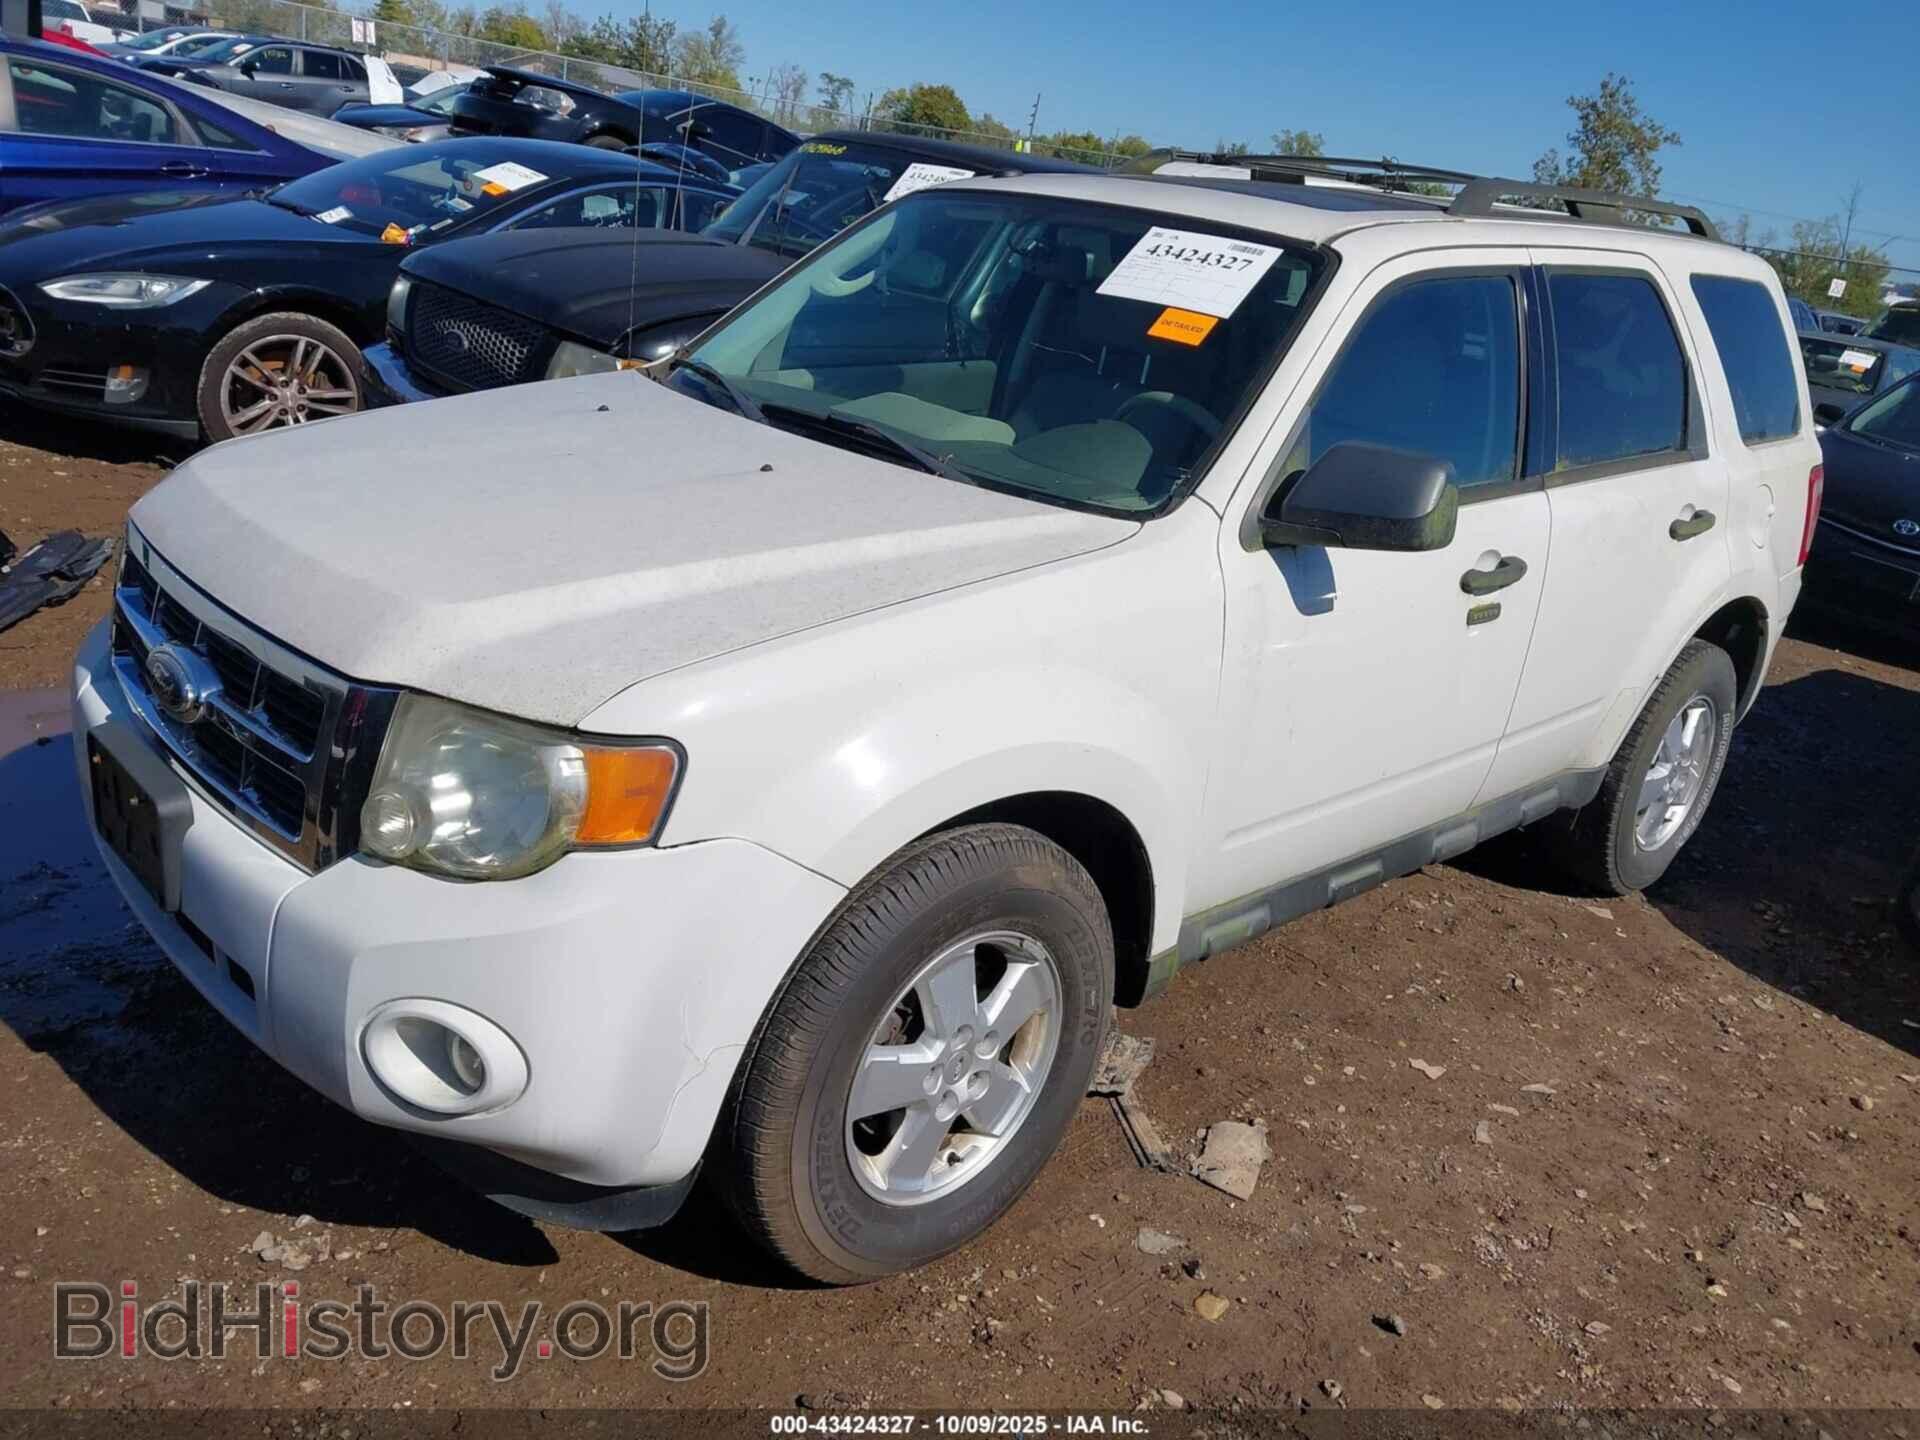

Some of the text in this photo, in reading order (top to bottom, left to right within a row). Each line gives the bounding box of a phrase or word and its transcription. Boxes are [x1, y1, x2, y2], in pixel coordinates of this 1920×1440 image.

[1146, 243, 1254, 272] 43424327
[1160, 319, 1204, 334] DETAILED
[815, 1109, 863, 1245] DEXTERO
